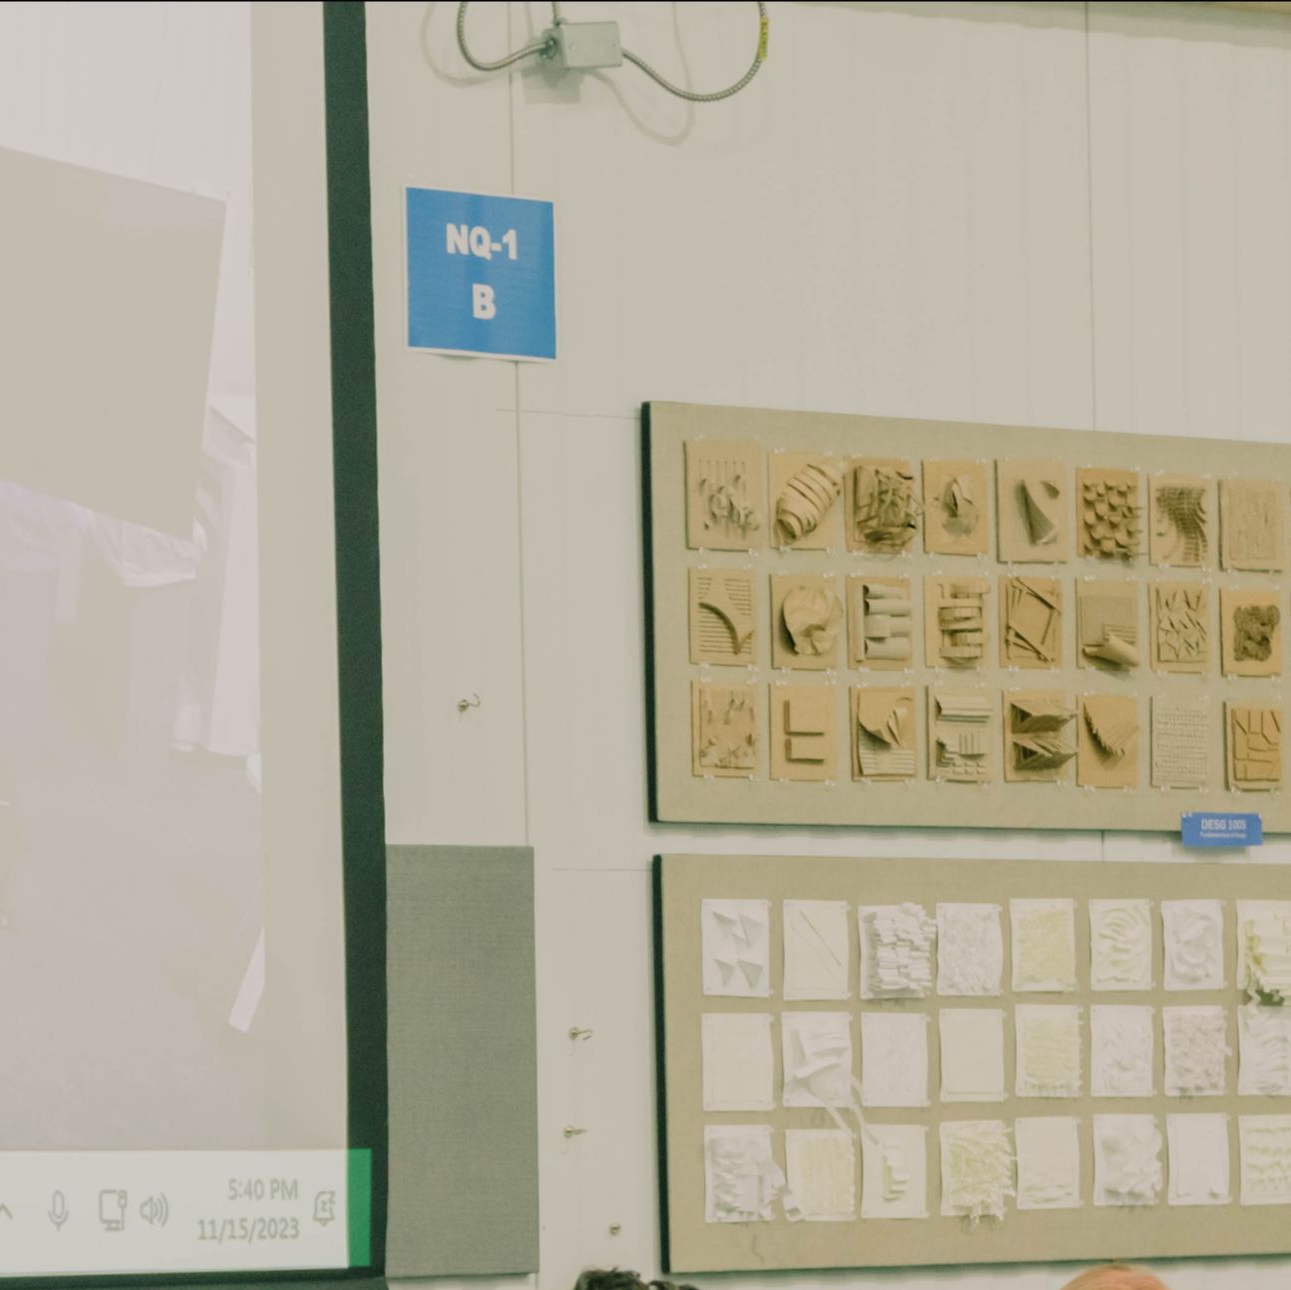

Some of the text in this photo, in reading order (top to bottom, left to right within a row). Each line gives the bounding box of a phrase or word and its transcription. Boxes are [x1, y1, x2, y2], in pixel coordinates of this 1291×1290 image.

[446, 223, 518, 260] NQ-1
[472, 283, 497, 320] B
[227, 1178, 299, 1201] 5:40 PM
[197, 1217, 300, 1245] 11/15/2023
